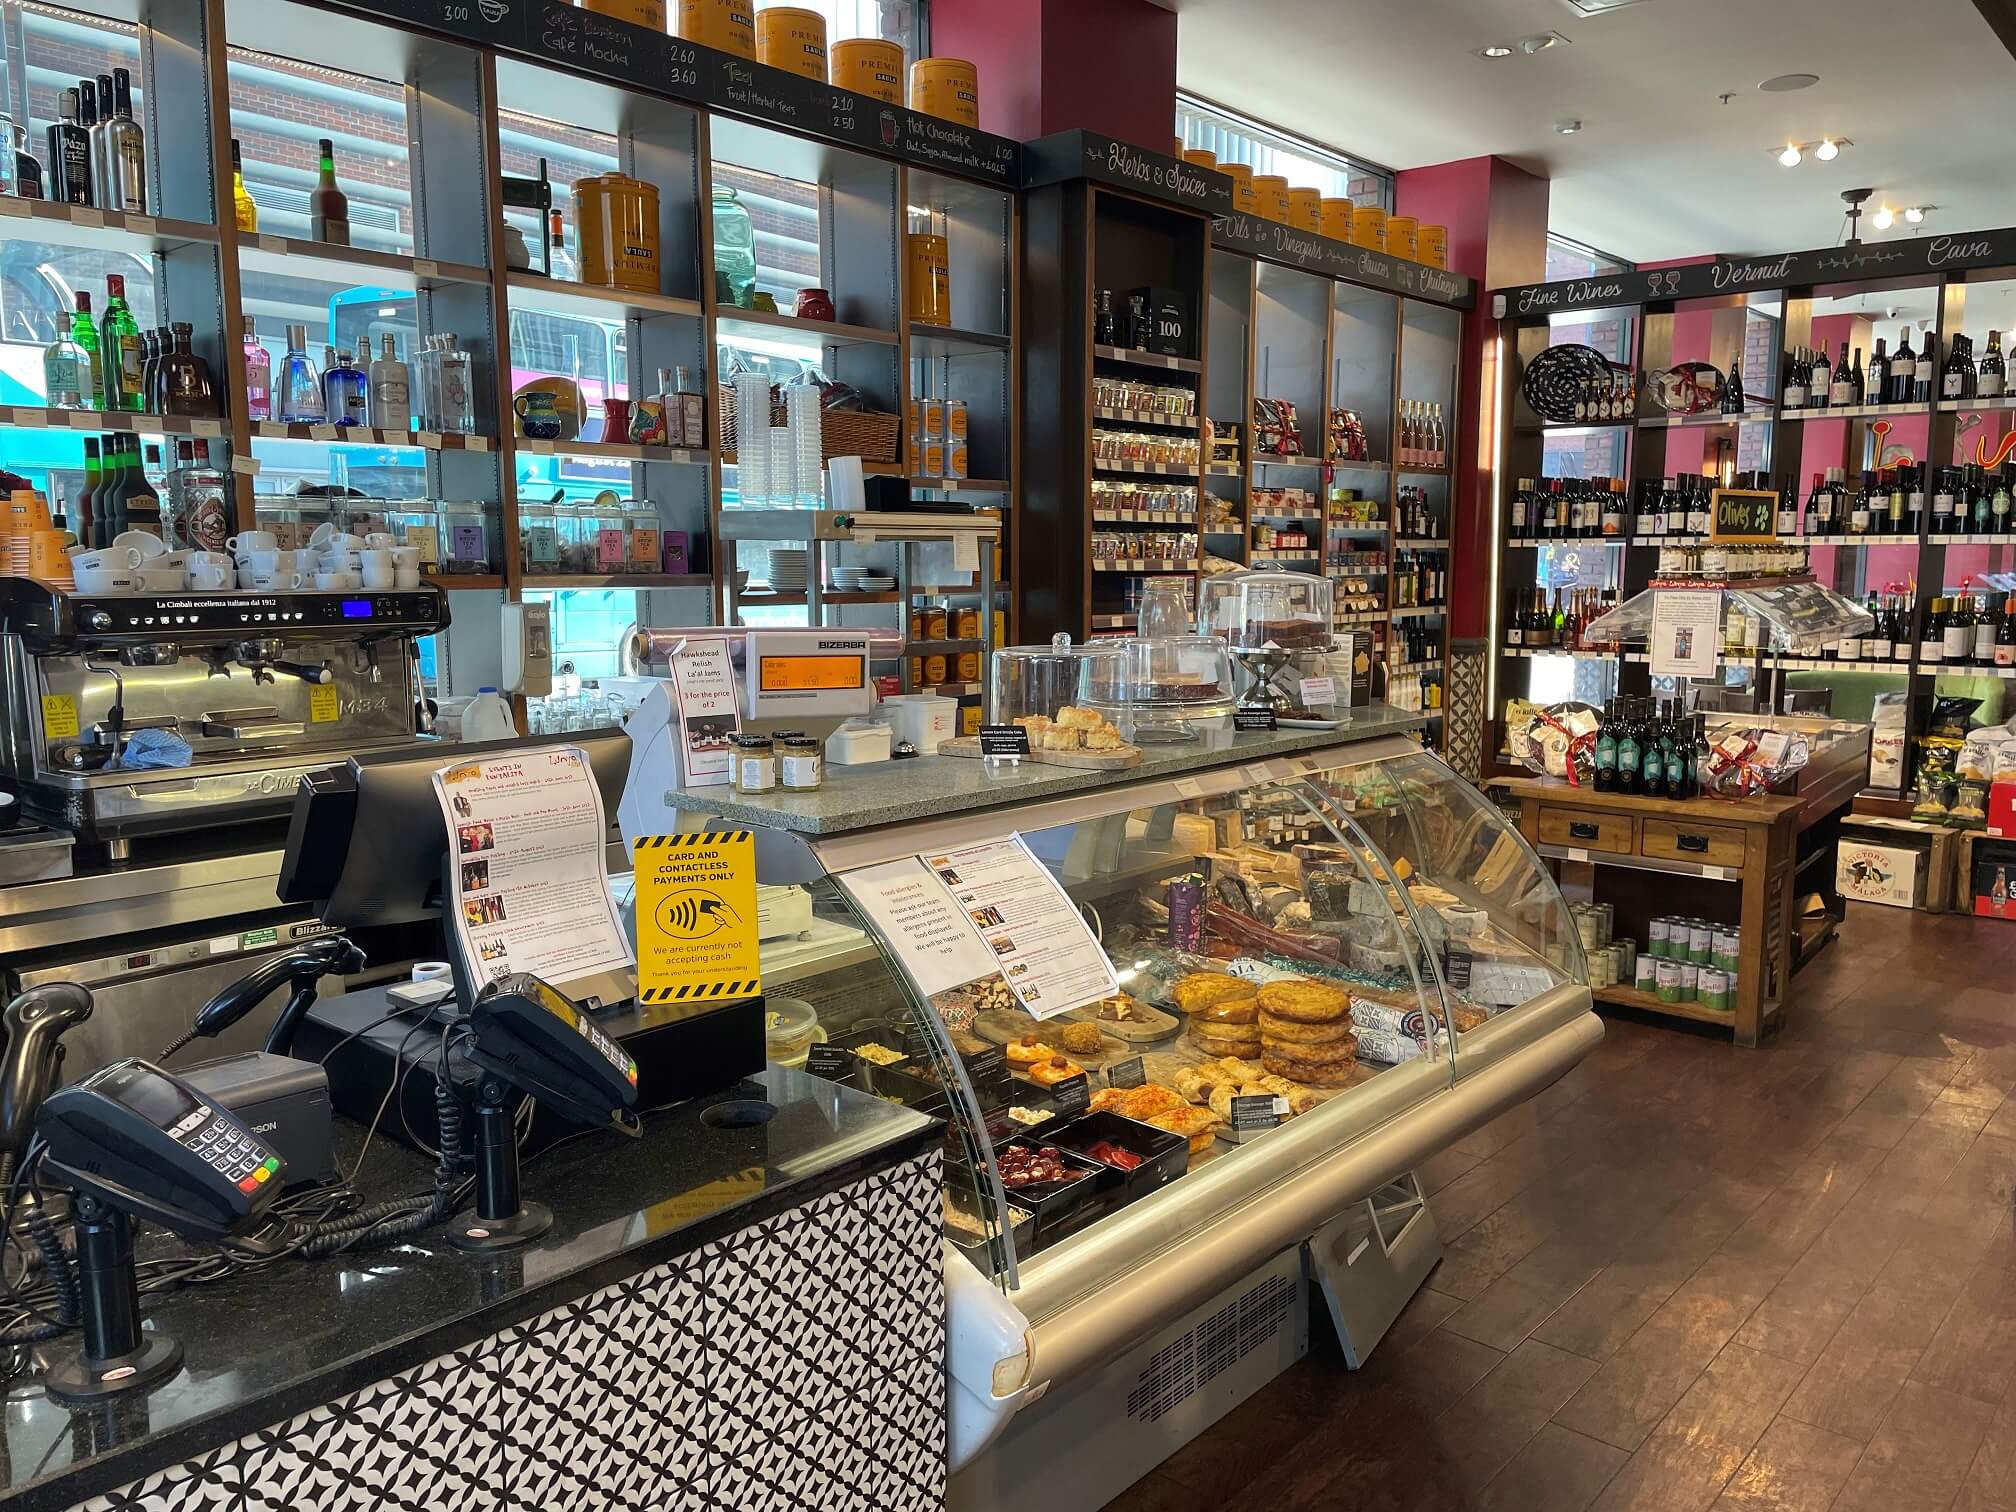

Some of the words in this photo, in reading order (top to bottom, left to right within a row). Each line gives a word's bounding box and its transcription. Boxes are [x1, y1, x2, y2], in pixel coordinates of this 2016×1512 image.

[584, 41, 630, 66] Mocha
[907, 114, 926, 138] Hot
[926, 122, 972, 149] Chocolate
[1109, 142, 1151, 182] Herbs
[1154, 167, 1163, 184] &
[1166, 162, 1207, 198] Spices
[1225, 215, 1250, 240] Oils
[1274, 227, 1323, 263] Vinegars
[1358, 252, 1390, 279] Sauces
[1419, 266, 1459, 297] Chutneys
[1518, 287, 1559, 313] Fine
[1567, 281, 1622, 304] Wines
[1712, 252, 1799, 289] Vermut
[1927, 236, 1992, 266] Cava
[1160, 320, 1181, 338] 100
[1718, 500, 1750, 530] Olives
[157, 601, 166, 609] La
[167, 600, 193, 608] Cimbali
[194, 600, 227, 608] eccellenza
[819, 641, 866, 649] BIZERBA
[681, 649, 720, 659] Hawkshead
[690, 691, 700, 699] for
[701, 690, 712, 698] the
[713, 691, 730, 700] price
[702, 701, 710, 709] of
[667, 852, 695, 862] CARD
[697, 851, 719, 860] AND
[1848, 851, 1889, 869] VICTORIA
[658, 861, 729, 873] CONTACTLESS
[653, 874, 707, 885] PAYMENTS
[709, 872, 735, 881] ONLY
[889, 907, 907, 915] Please
[896, 914, 922, 924] members
[922, 909, 937, 918] about
[937, 906, 947, 914] any
[903, 922, 927, 932] allergens
[926, 916, 945, 926] present
[914, 931, 928, 939] food
[653, 947, 668, 955] We
[686, 943, 726, 953] currently
[727, 941, 743, 949] not
[915, 943, 926, 952] We
[926, 939, 936, 948] will
[943, 934, 959, 944] happy
[665, 954, 709, 965] accepting
[710, 952, 732, 961] cash
[250, 1120, 278, 1134] SON
